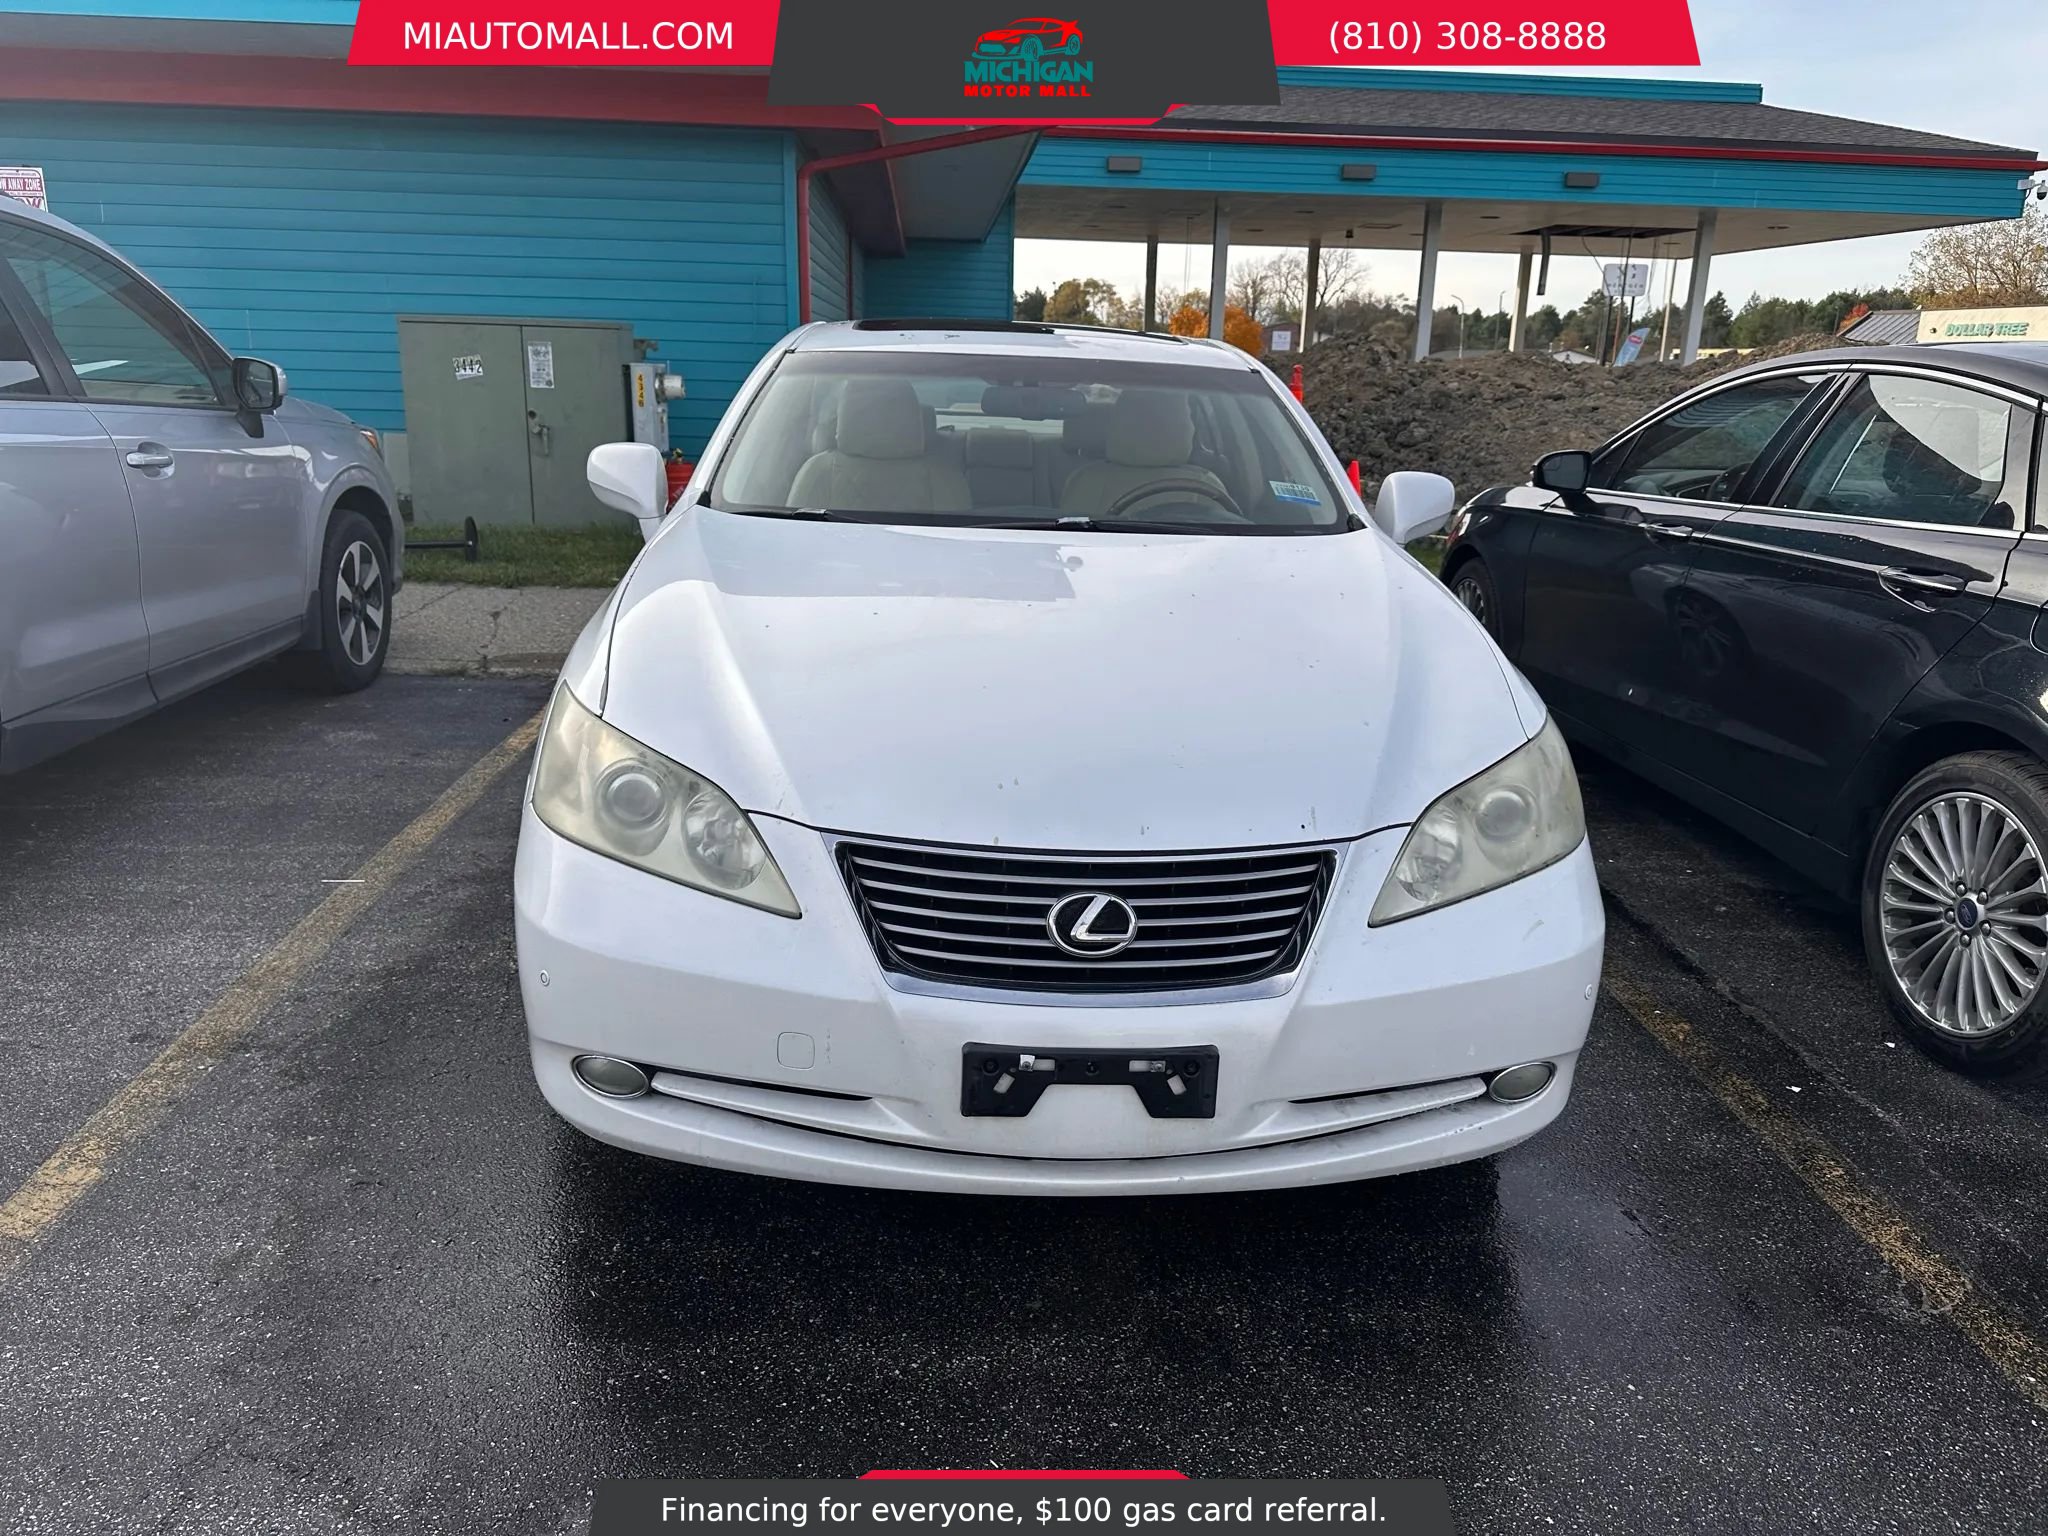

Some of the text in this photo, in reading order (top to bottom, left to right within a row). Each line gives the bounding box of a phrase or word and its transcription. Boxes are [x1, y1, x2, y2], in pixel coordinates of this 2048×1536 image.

[25, 178, 41, 190] ZONE
[1946, 322, 2029, 337] DOLLAR TREE
[454, 358, 482, 373] 3442
